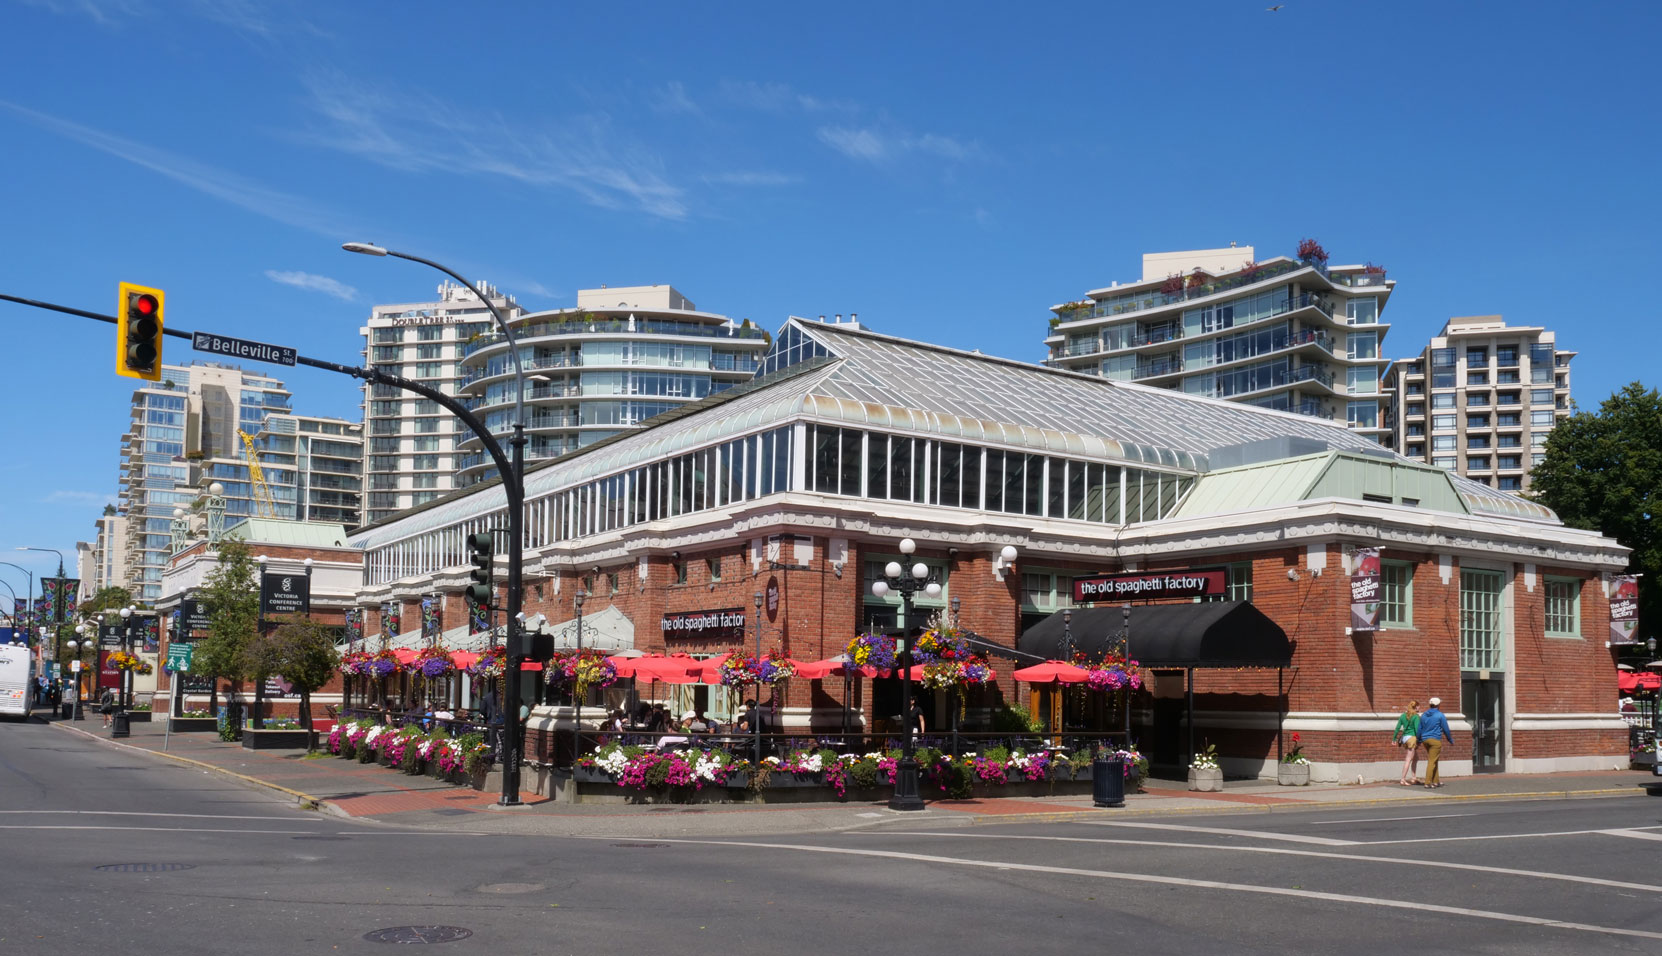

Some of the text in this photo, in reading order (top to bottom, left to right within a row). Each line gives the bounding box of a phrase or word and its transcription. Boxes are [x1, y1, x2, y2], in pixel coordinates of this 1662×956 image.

[212, 338, 279, 361] Belleville
[283, 349, 292, 357] St.
[1081, 576, 1204, 594] the old spaghetti factory
[1353, 590, 1374, 599] factory
[661, 612, 746, 631] the old spaghetti factor
